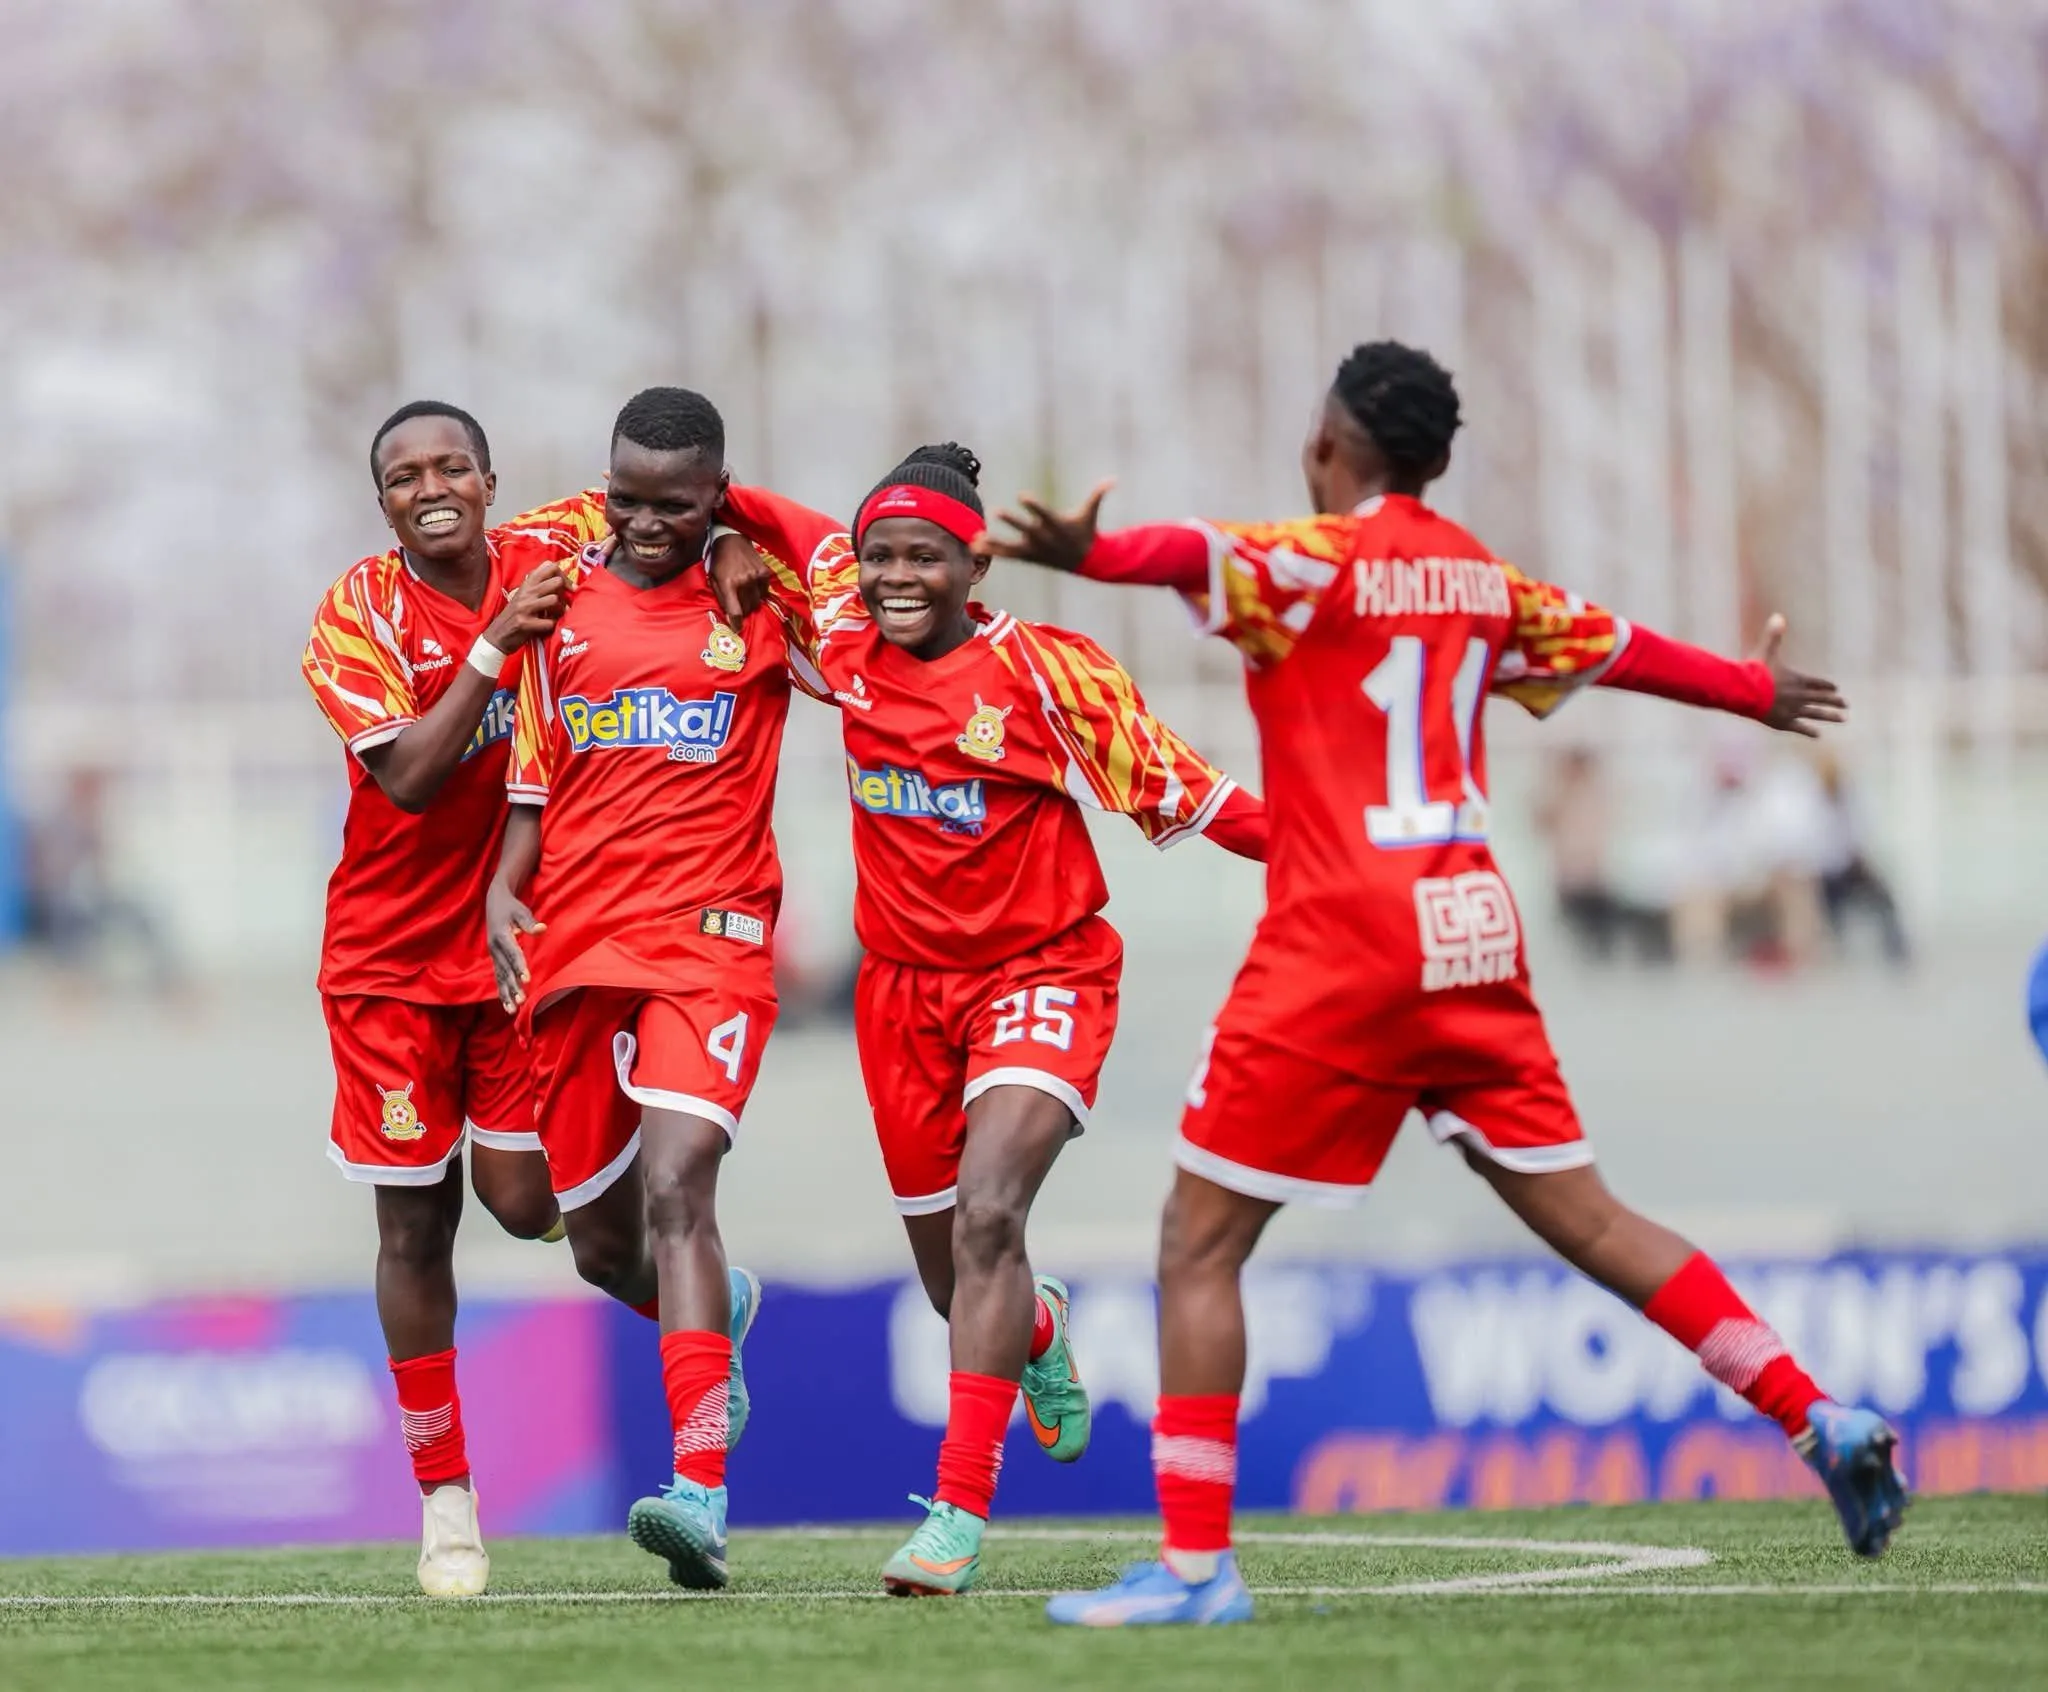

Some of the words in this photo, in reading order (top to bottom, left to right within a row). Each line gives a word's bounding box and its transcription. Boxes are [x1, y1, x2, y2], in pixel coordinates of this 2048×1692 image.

[1353, 556, 1512, 618] KUNIHIRA
[563, 695, 730, 747] Betika!
[847, 753, 982, 819] Betika!
[728, 921, 761, 936] POLICE
[707, 1010, 748, 1083] 4
[992, 985, 1078, 1051] 25
